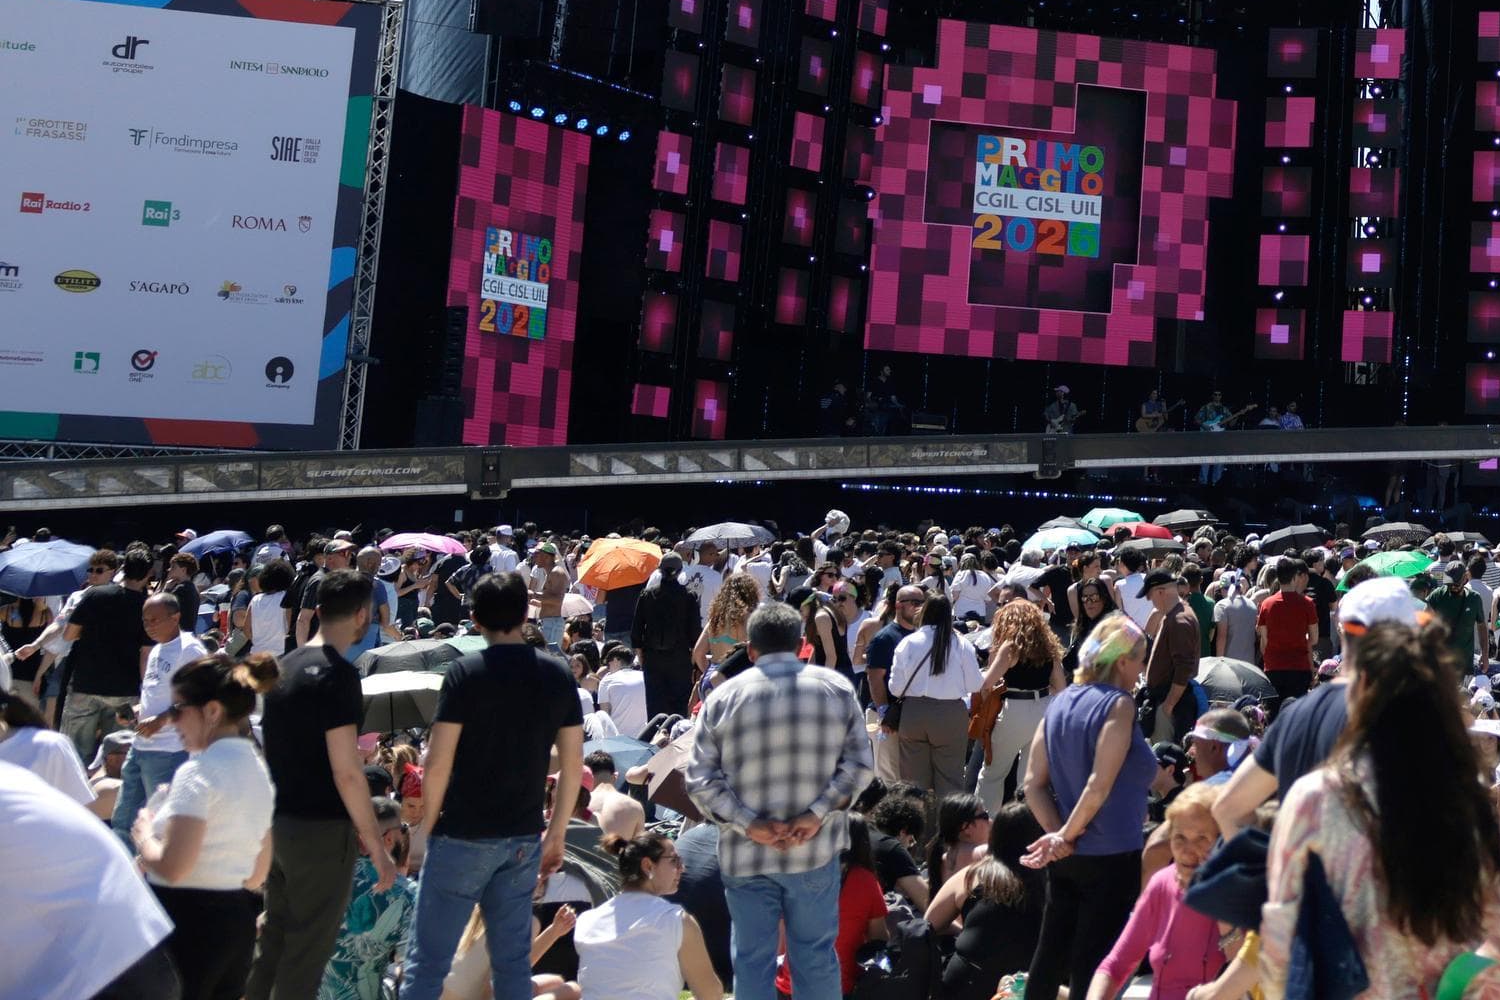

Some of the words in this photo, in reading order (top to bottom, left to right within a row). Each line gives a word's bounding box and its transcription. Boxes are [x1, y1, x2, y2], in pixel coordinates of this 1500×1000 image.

[0, 40, 36, 52] itude
[230, 60, 263, 72] INTESA
[29, 118, 74, 131] GROTTE
[76, 122, 87, 132] DI
[155, 131, 239, 155] Fondimpresa
[270, 135, 302, 162] SIAE
[977, 135, 1105, 173] PRIMO
[975, 162, 1104, 195] MAGGIO
[23, 198, 42, 208] Rai
[45, 199, 81, 211] Radio
[83, 202, 91, 212] 2
[145, 207, 169, 220] Rai
[171, 210, 181, 221] 3
[976, 191, 1018, 209] CGIL
[1025, 195, 1064, 213] CISL
[1071, 200, 1099, 217] UIL
[232, 215, 287, 232] ROMA
[485, 227, 552, 264] PRIMO
[973, 214, 1100, 258] 2026
[130, 281, 190, 295] S'AGAPÒ
[482, 279, 505, 295] CGIL
[508, 283, 529, 299] CISL
[532, 287, 547, 303] UIL
